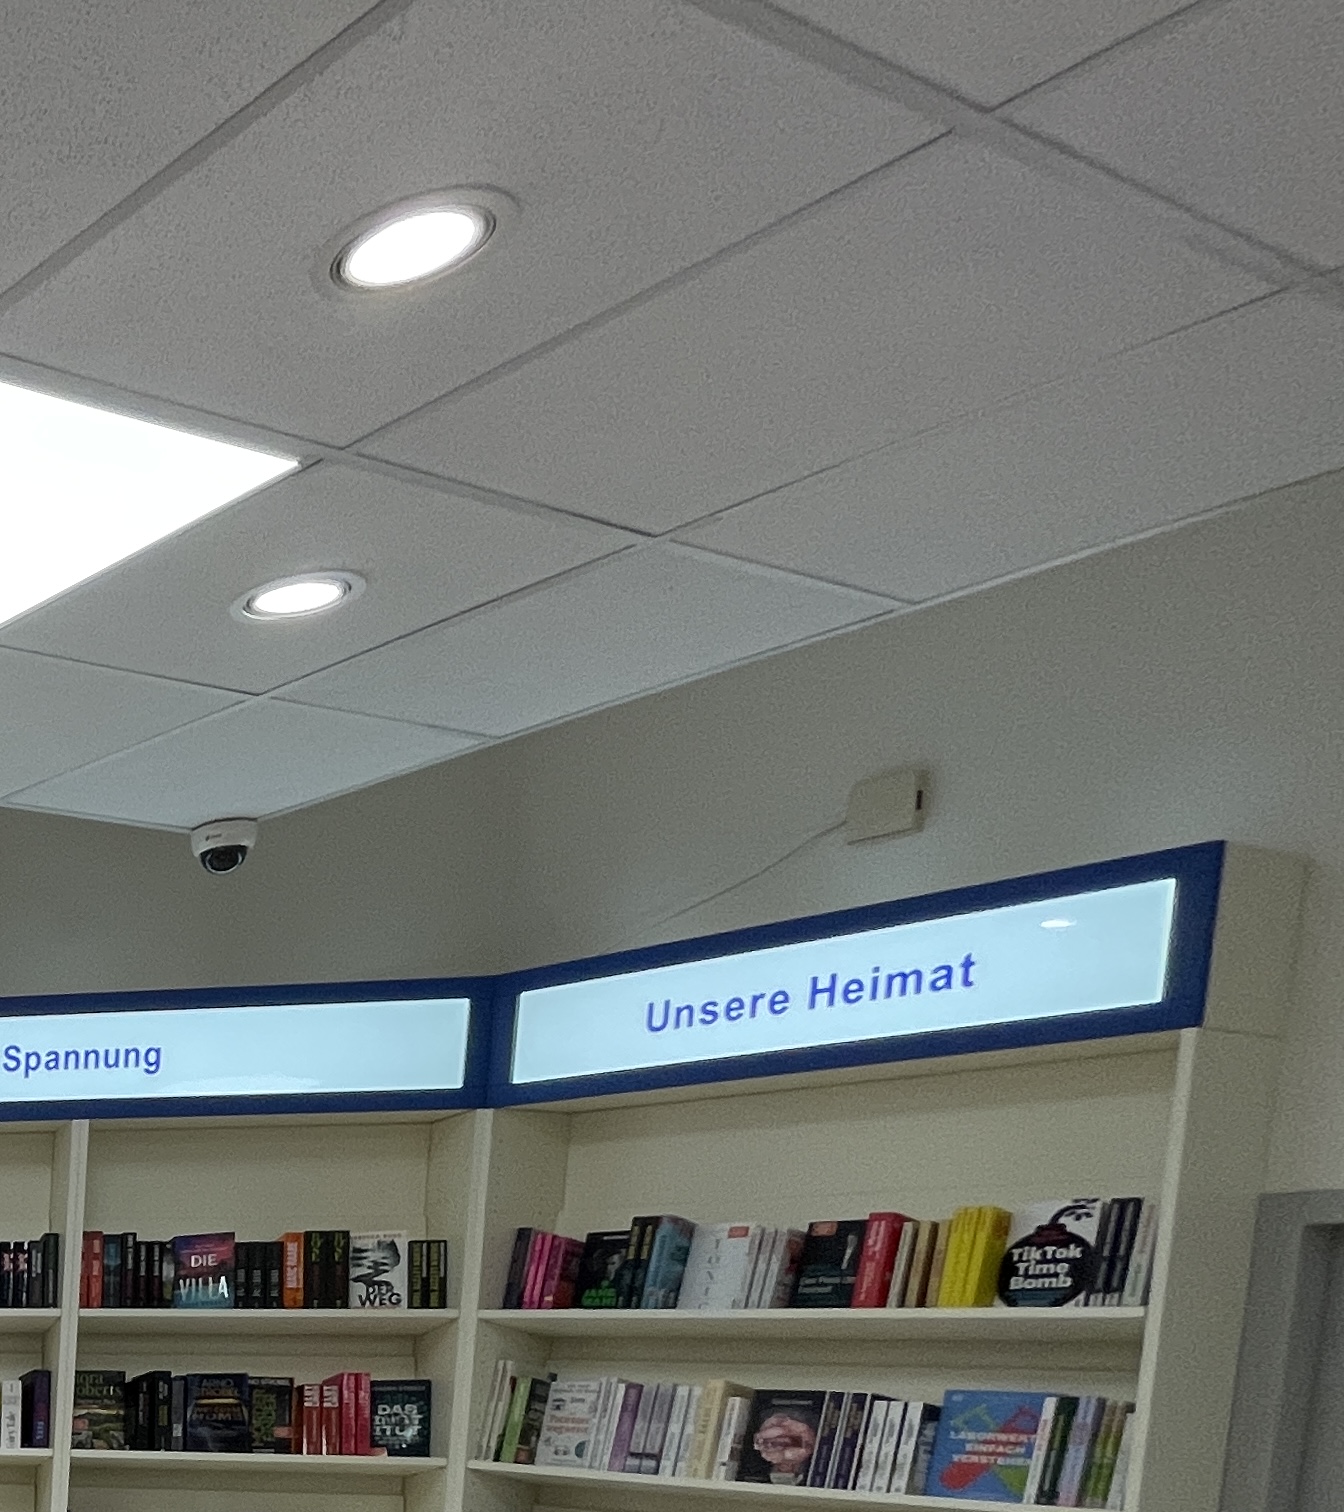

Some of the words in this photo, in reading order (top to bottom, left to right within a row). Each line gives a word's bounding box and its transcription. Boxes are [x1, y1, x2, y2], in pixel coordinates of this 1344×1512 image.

[645, 982, 790, 1033] Unsere
[807, 953, 976, 1010] Heimat
[2, 1043, 162, 1077] Spannung
[190, 1253, 217, 1268] DIE
[1011, 1245, 1083, 1261] TikTok
[1014, 1261, 1069, 1277] Time
[179, 1275, 230, 1300] VILLA
[1009, 1275, 1072, 1291] Bomb
[358, 1291, 402, 1308] WEG
